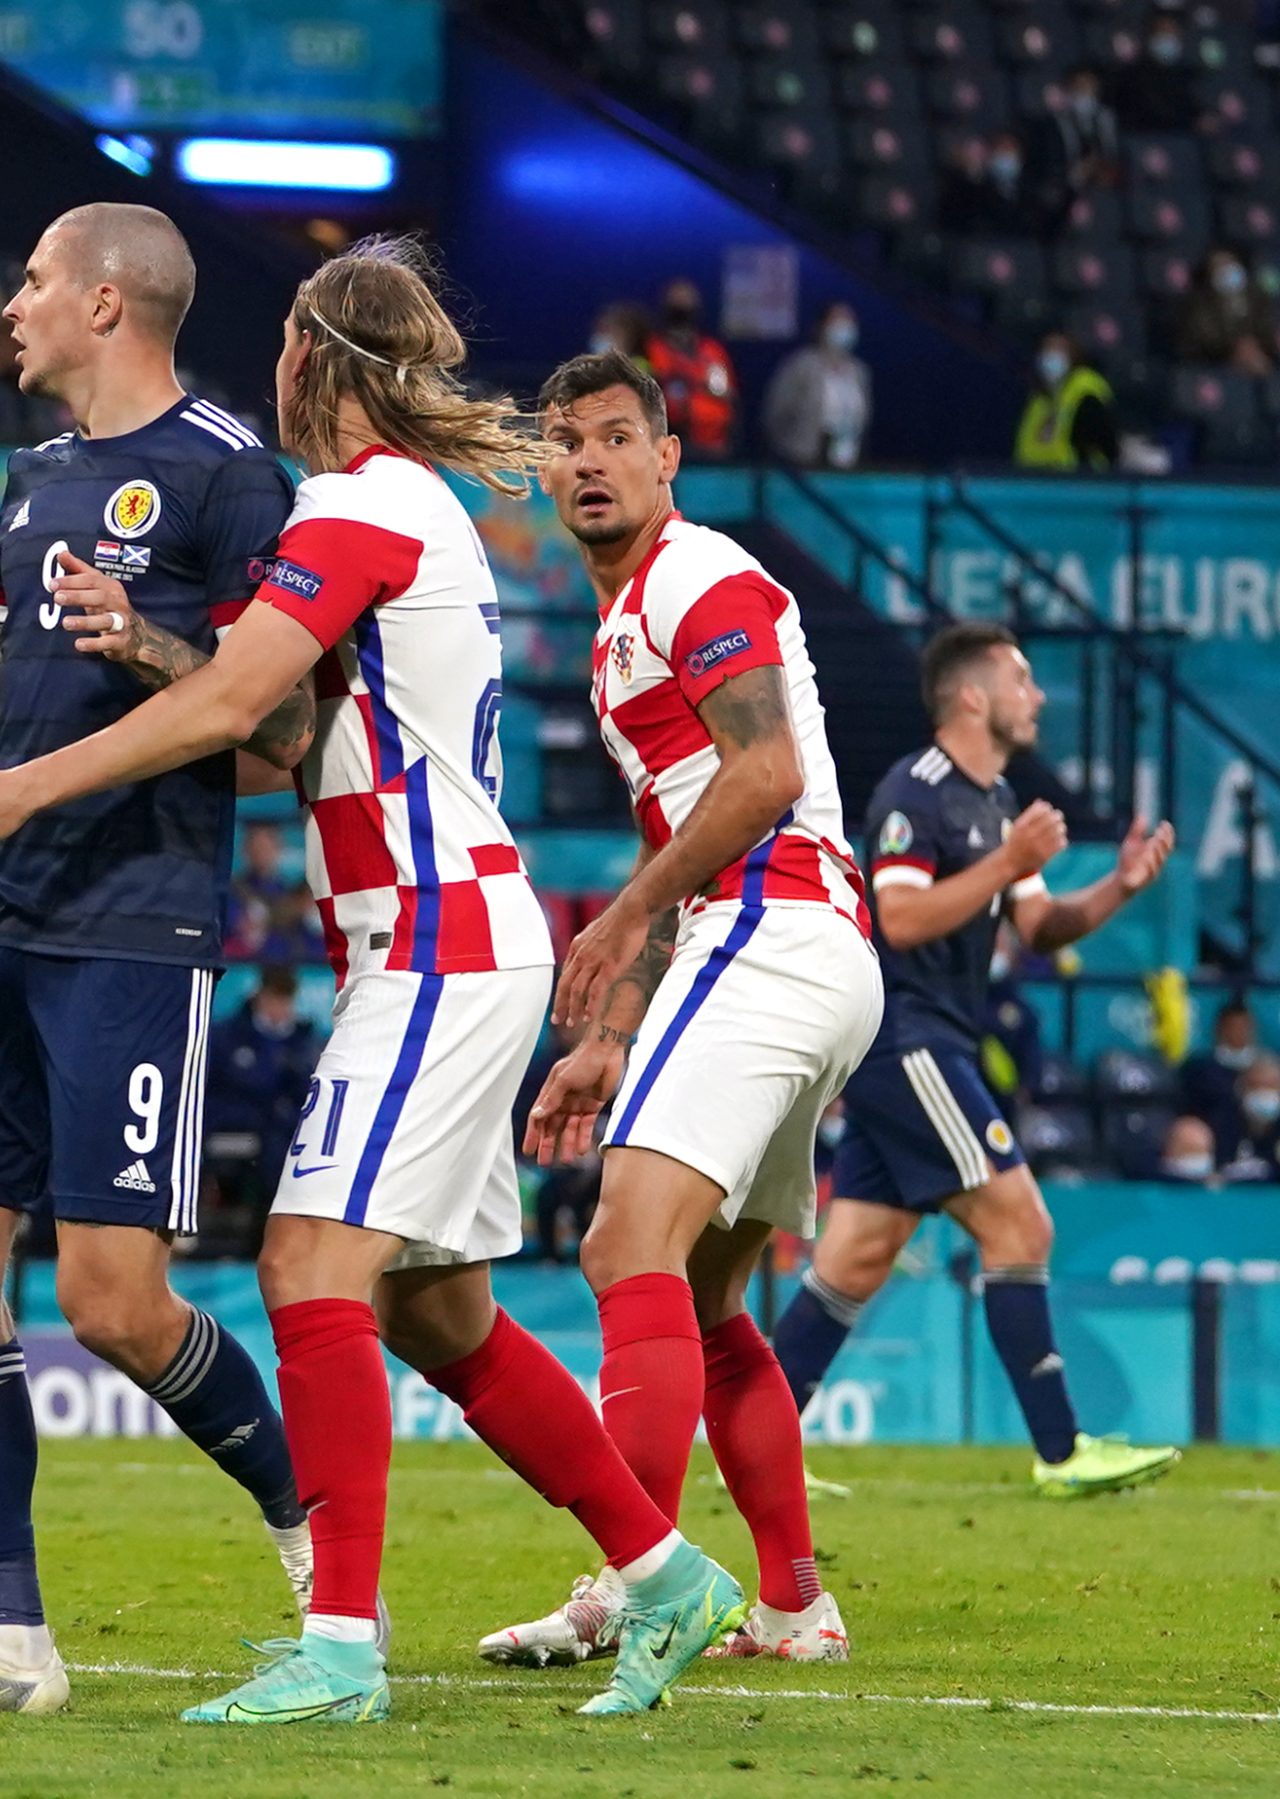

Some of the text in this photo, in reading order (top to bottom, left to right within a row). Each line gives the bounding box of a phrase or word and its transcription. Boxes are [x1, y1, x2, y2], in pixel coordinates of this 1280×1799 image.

[38, 540, 71, 631] 9
[1112, 556, 1280, 642] EUR
[703, 632, 749, 664] RESPECT
[123, 1062, 163, 1154] 9
[113, 1176, 156, 1193] adidas
[798, 1380, 874, 1443] 20
